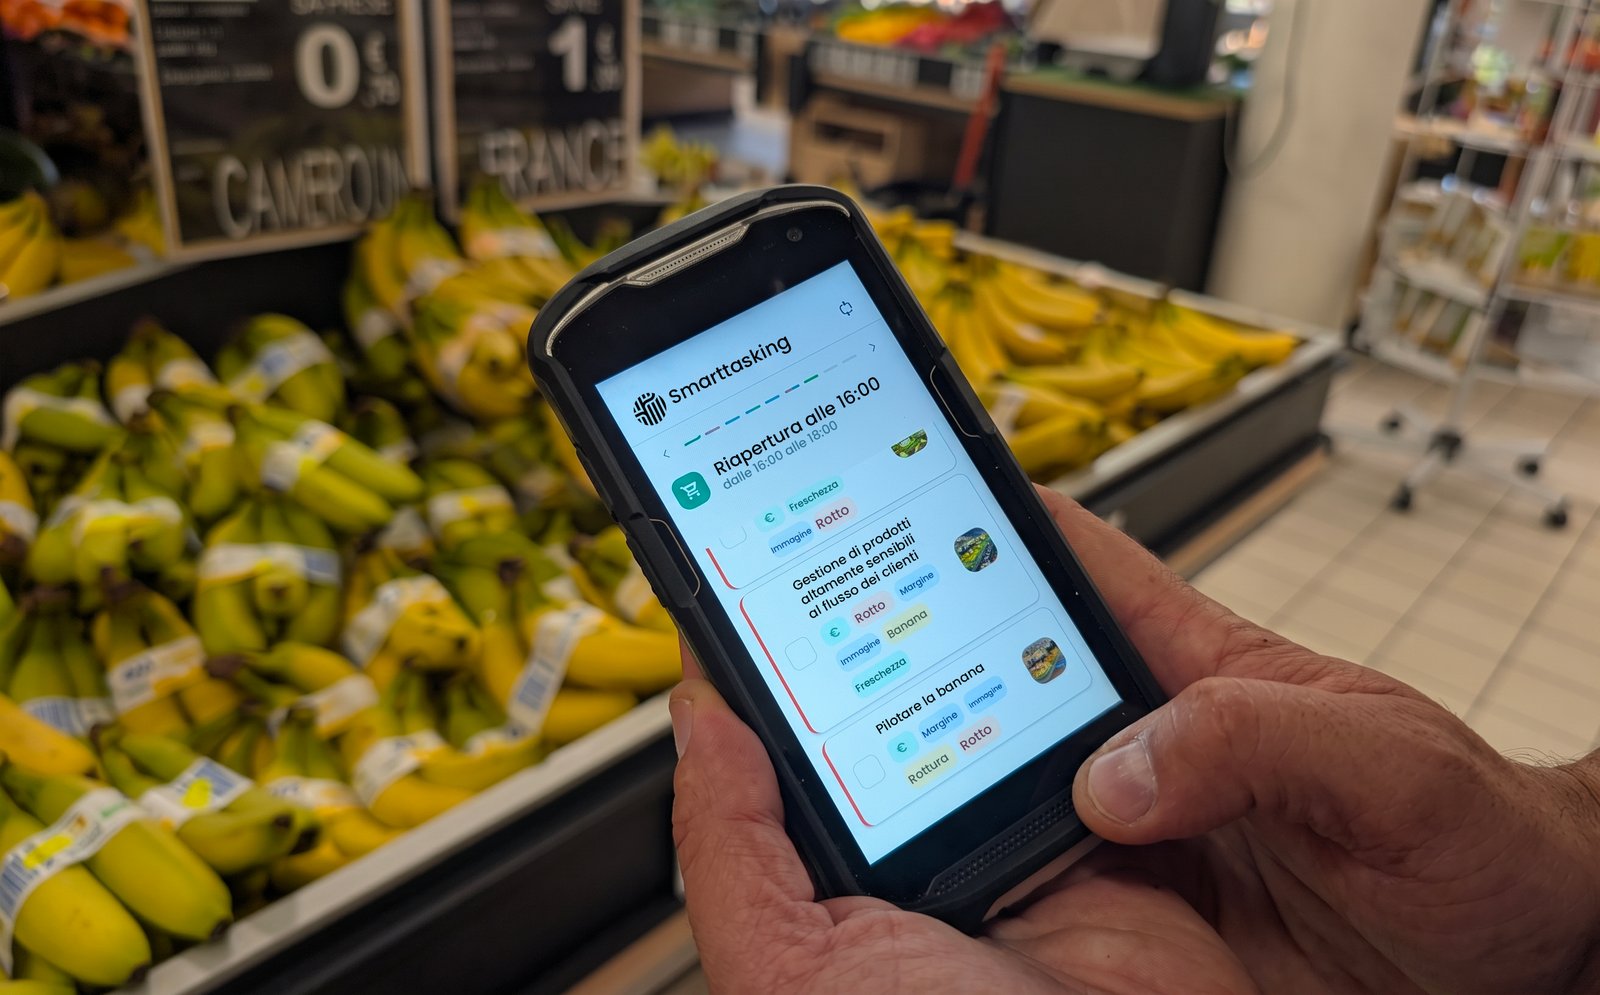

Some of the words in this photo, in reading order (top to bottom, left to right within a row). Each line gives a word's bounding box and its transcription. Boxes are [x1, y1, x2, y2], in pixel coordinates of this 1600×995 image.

[294, 24, 361, 109] 0
[548, 17, 587, 93] 1
[668, 336, 792, 404] Smarttasking
[713, 421, 803, 475] Riapertura
[806, 402, 836, 426] alle
[836, 377, 881, 409] 16:00
[723, 467, 752, 490] dalle
[753, 450, 783, 473] 16:00
[786, 439, 807, 456] alle
[807, 421, 838, 443] 18:00
[771, 527, 812, 554] Immagine
[816, 506, 849, 530] Rotto
[789, 480, 839, 512] Freschezza
[793, 554, 847, 591] Gestione
[849, 546, 860, 559] di
[862, 517, 912, 554] prodotti
[801, 563, 864, 605] altamente
[866, 533, 915, 568] sensibili
[809, 605, 822, 619] al
[822, 585, 859, 613] flusso
[861, 571, 880, 590] dei
[882, 550, 919, 578] clienti
[854, 600, 886, 623] Rotto
[899, 571, 935, 596] Margine
[840, 637, 881, 666] Immagine
[887, 609, 928, 639] Banana
[855, 657, 907, 693] Freschezza
[875, 700, 922, 735] Pilotare
[922, 692, 936, 708] la
[936, 662, 985, 698] banana
[922, 710, 958, 739] Margine
[968, 683, 1003, 709] Immagine
[908, 753, 949, 785] Rottura
[960, 725, 992, 751] Rotto
